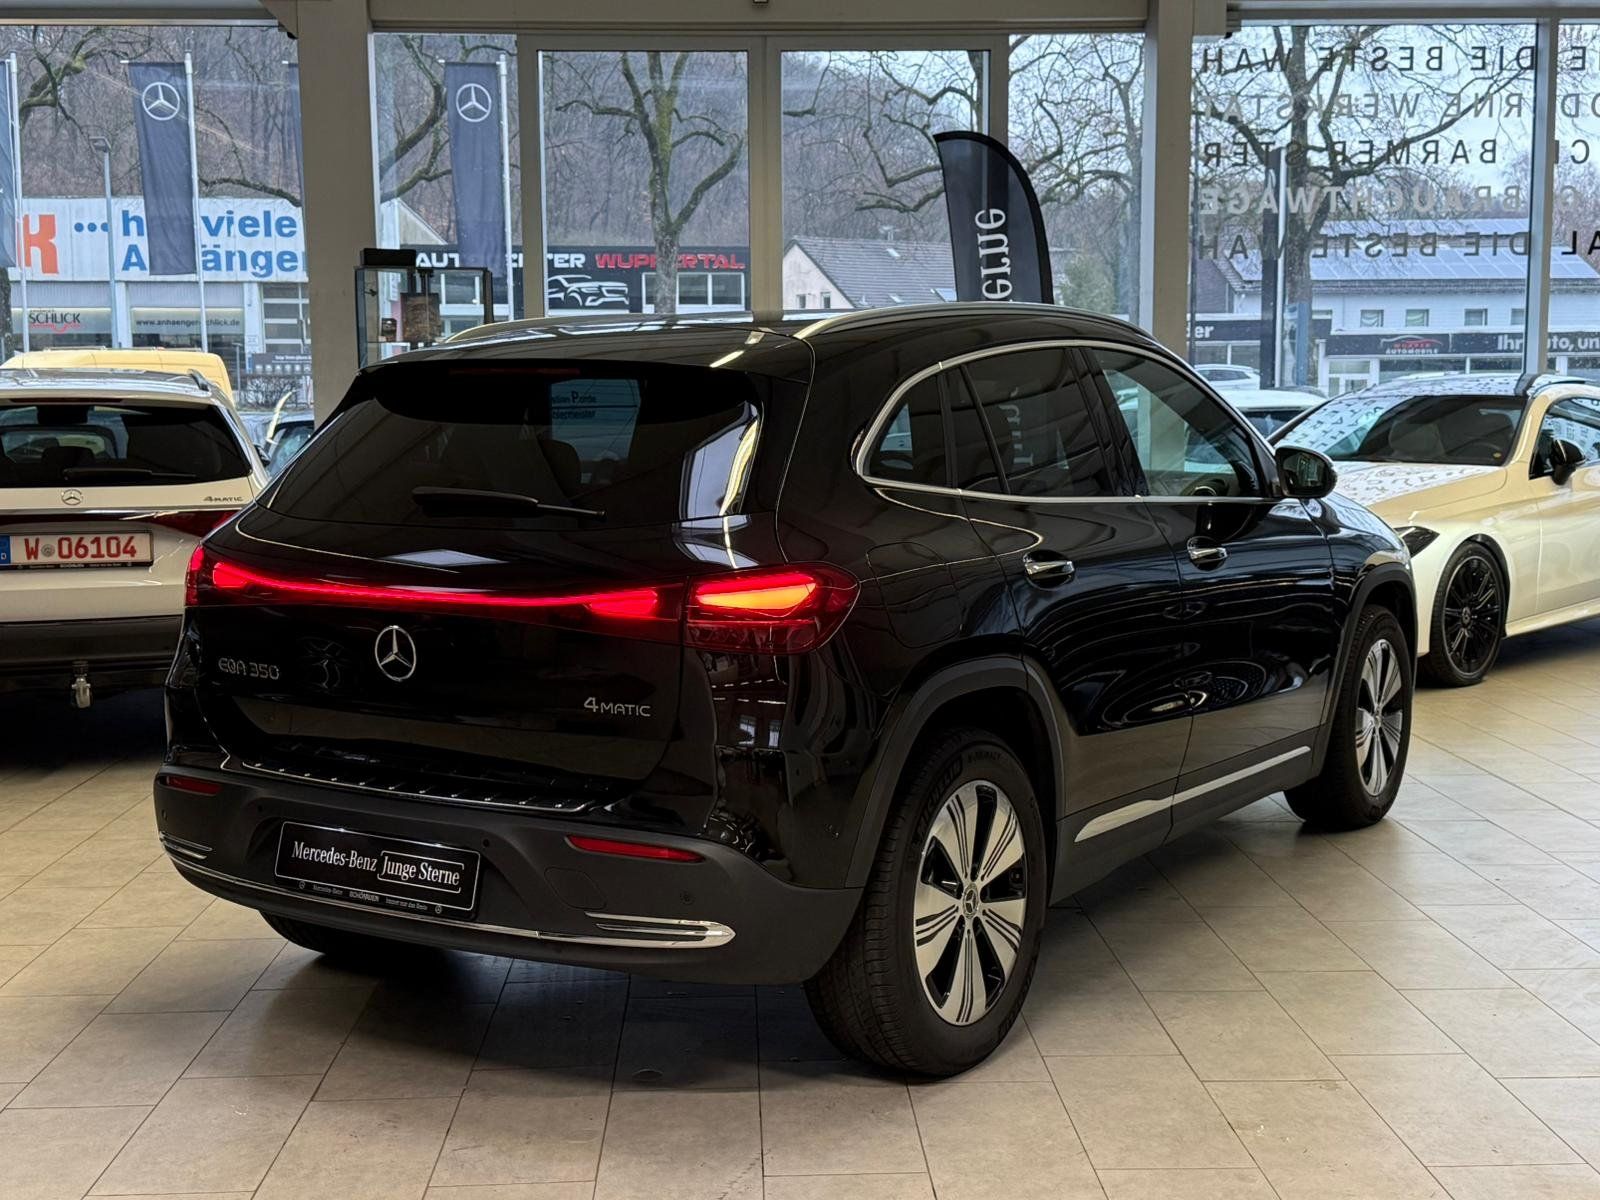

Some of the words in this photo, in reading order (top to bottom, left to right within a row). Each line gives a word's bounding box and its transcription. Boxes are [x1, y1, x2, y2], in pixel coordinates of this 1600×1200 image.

[200, 210, 298, 238] viele
[28, 312, 81, 325] SCHLICK
[24, 537, 41, 561] W
[57, 535, 138, 560] 06104
[218, 657, 247, 675] EQA
[248, 661, 280, 680] 350
[583, 696, 652, 718] 4MATIC
[291, 840, 379, 872] Mercedes-Benz
[381, 855, 416, 881] Junge
[418, 861, 461, 887] Sterne
